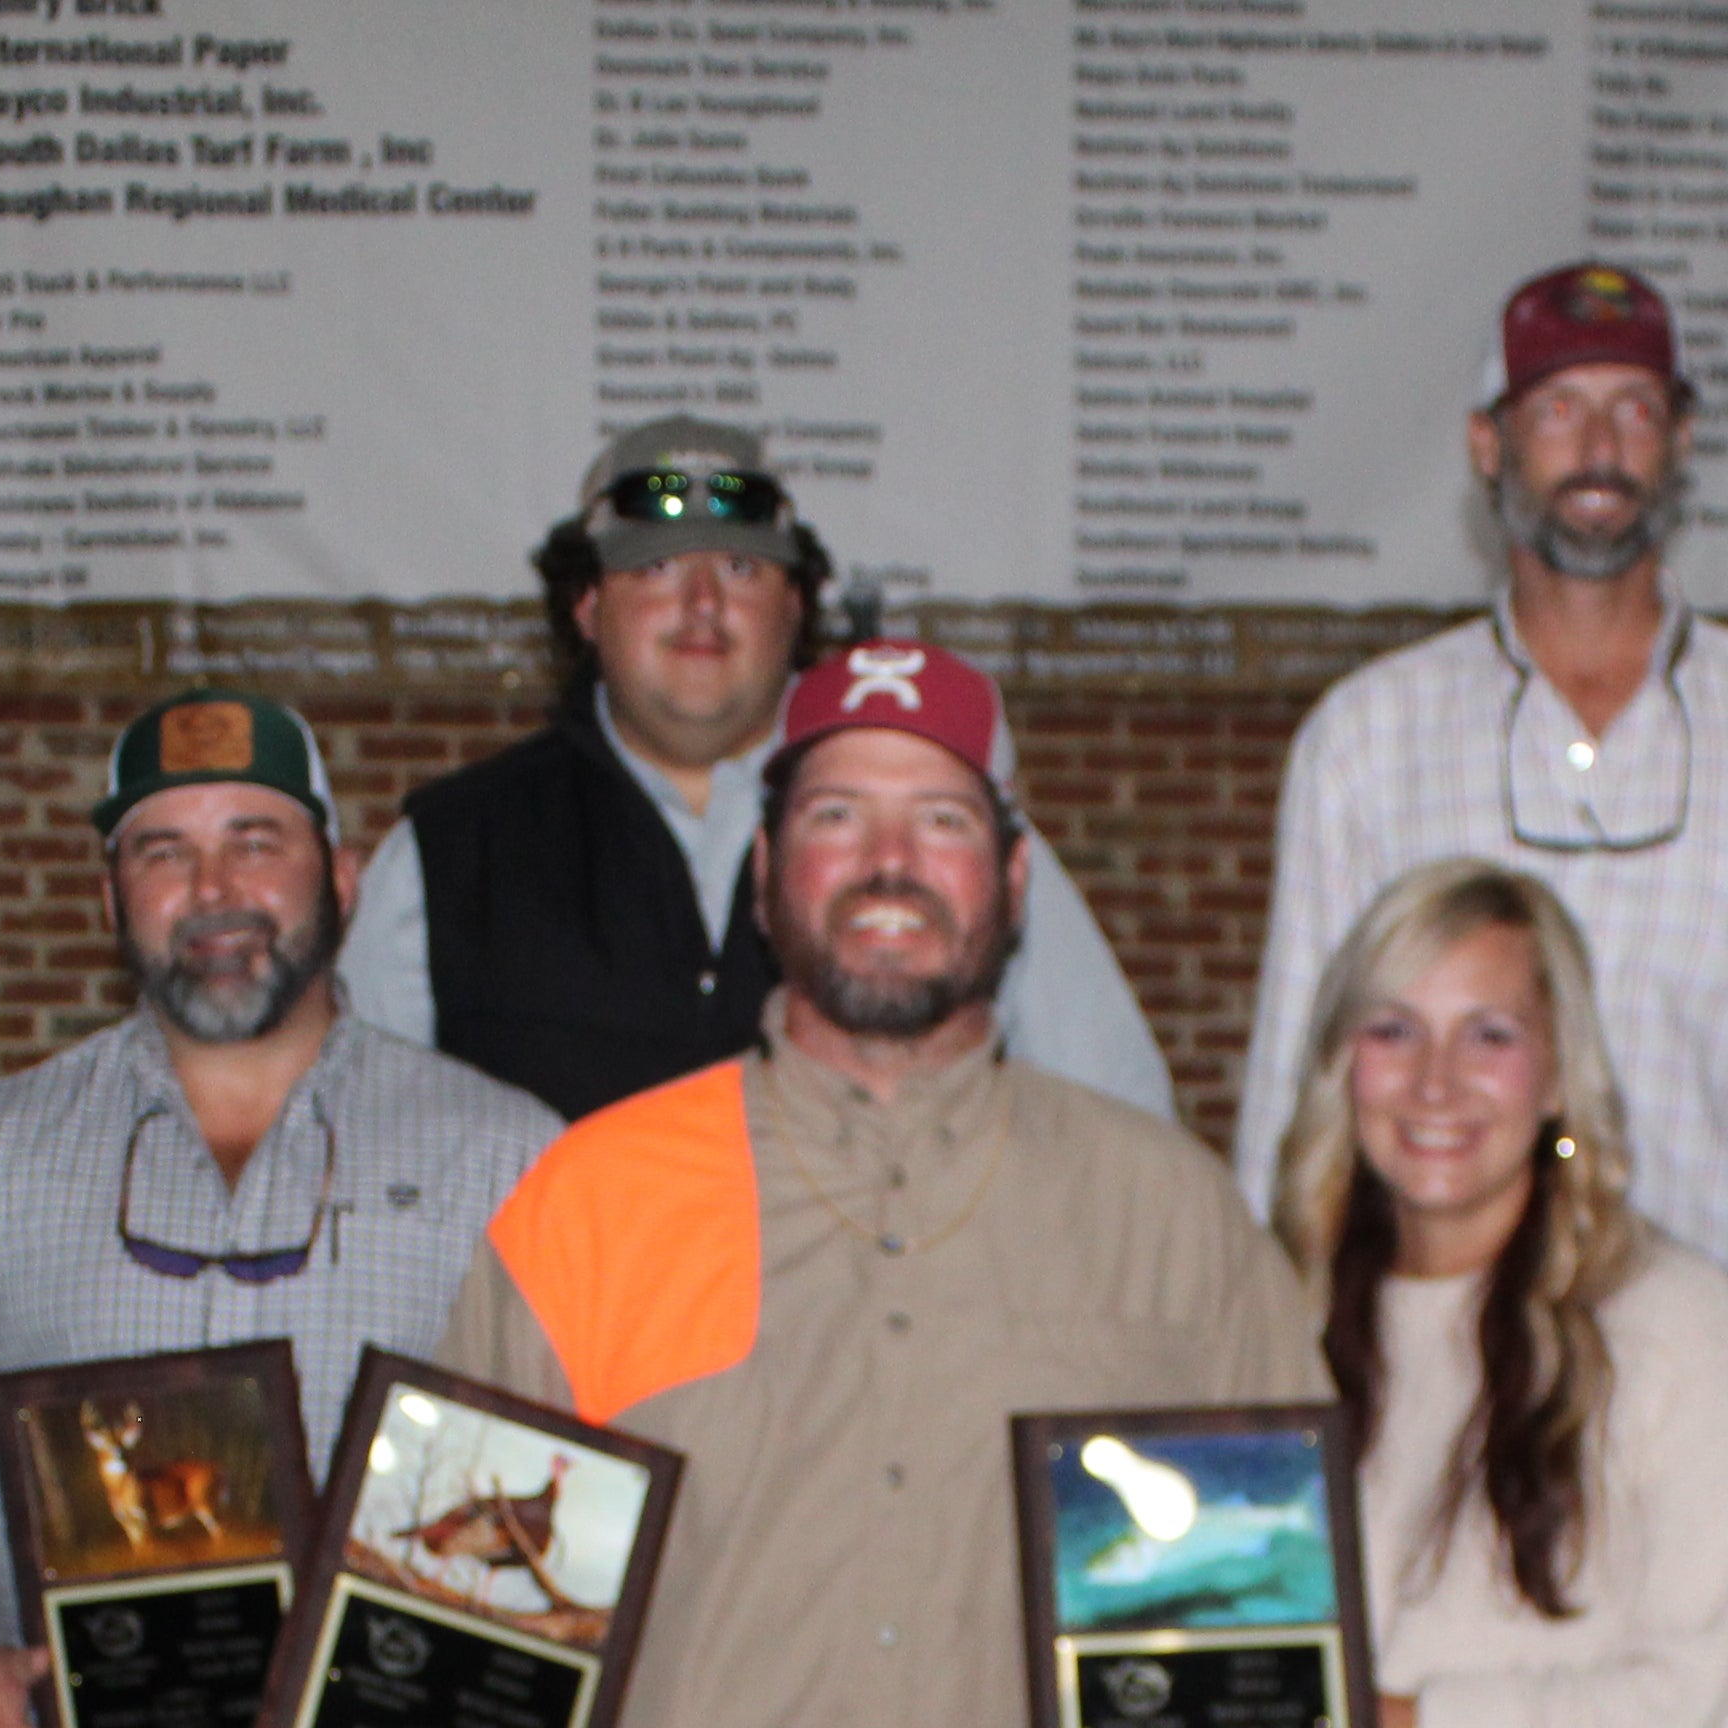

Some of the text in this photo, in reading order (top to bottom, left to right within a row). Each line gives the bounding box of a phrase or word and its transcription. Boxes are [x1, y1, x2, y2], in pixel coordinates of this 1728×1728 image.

[193, 37, 289, 72] Paper
[80, 86, 251, 121] Industrial,
[263, 87, 323, 117] Inc.
[75, 137, 178, 168] Dallas
[192, 136, 253, 166] Turf
[266, 137, 351, 166] Farm
[381, 136, 432, 166] Inc
[124, 186, 270, 222] Regional
[284, 185, 415, 216] Medical
[428, 184, 537, 215] Center
